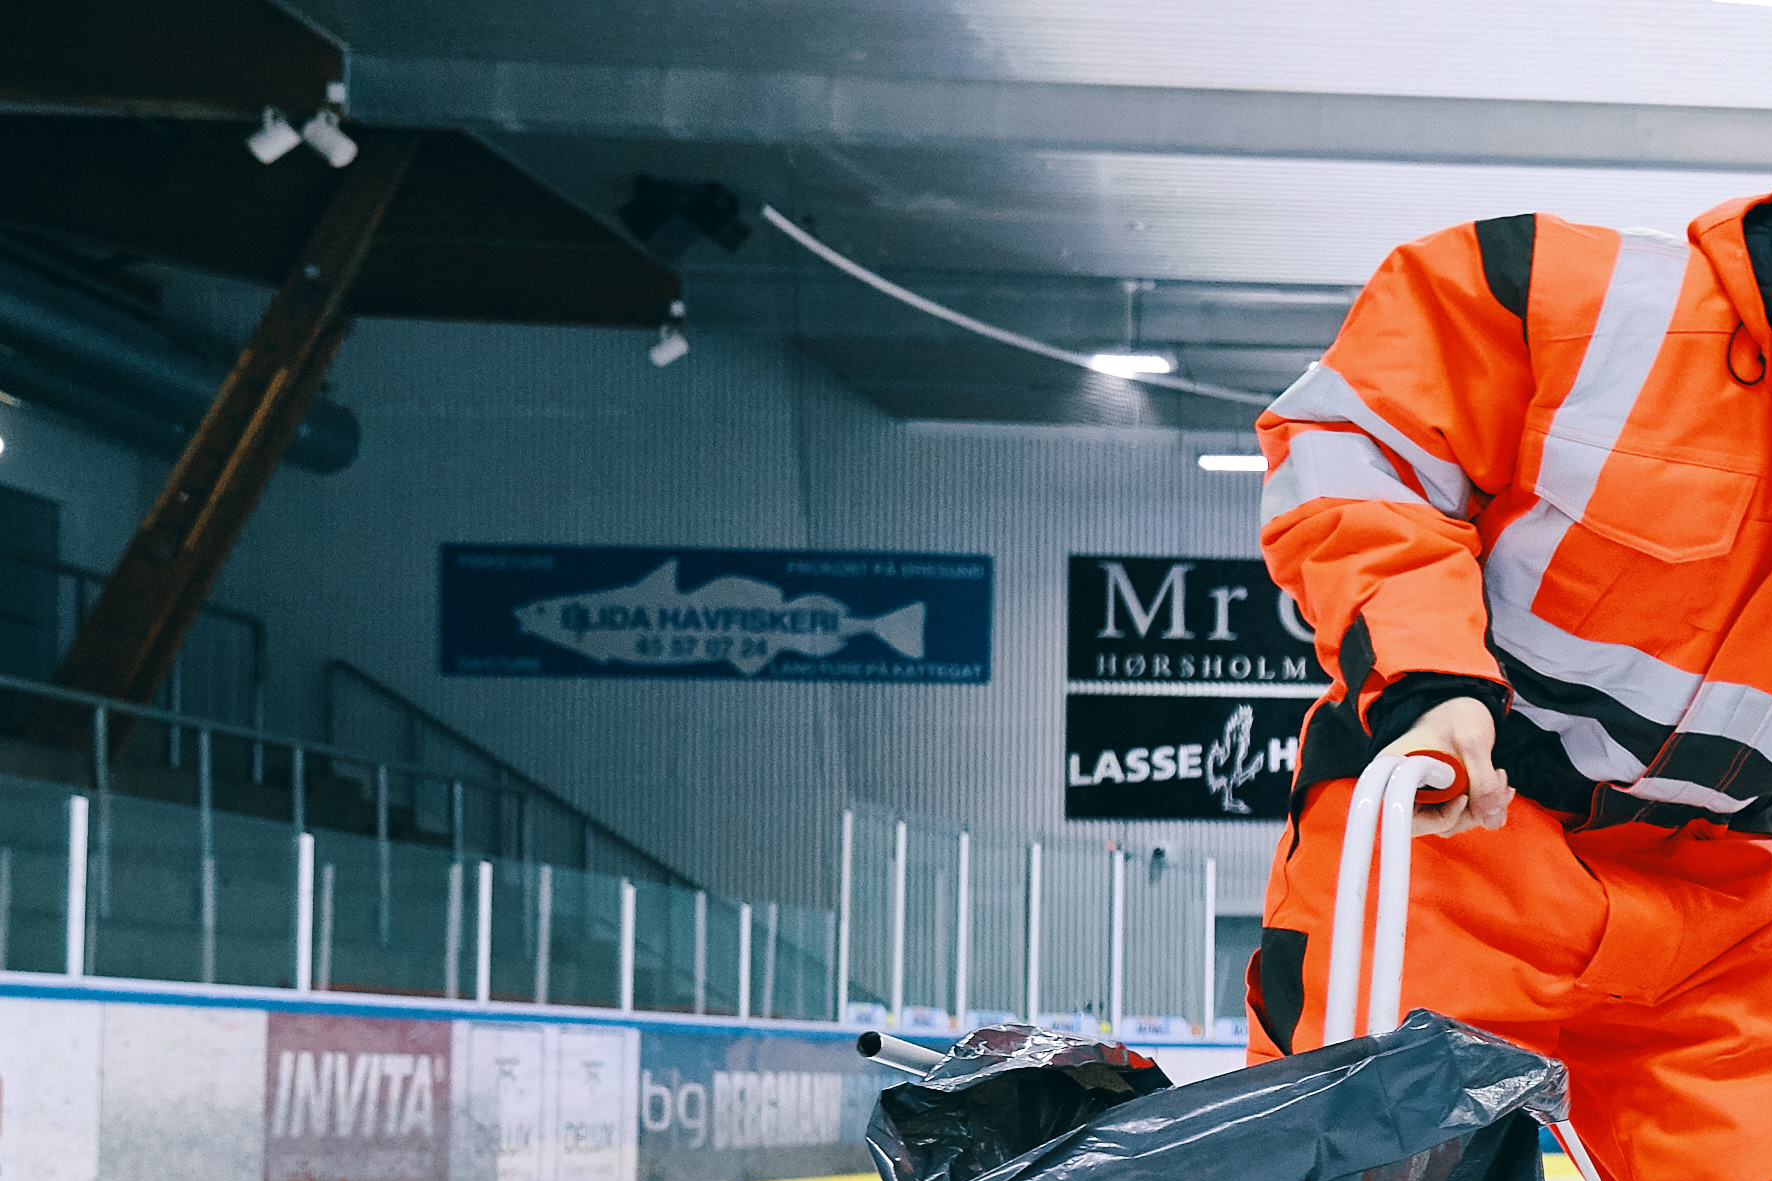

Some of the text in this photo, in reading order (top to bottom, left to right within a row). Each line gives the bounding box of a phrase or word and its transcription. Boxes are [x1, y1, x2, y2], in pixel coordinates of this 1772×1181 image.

[658, 605, 839, 633] HAVFISKERI
[1097, 560, 1249, 641] Mr
[1097, 652, 1307, 680] HØRSHOLM
[1069, 743, 1203, 787] LASSE
[272, 1050, 434, 1139] INVITA
